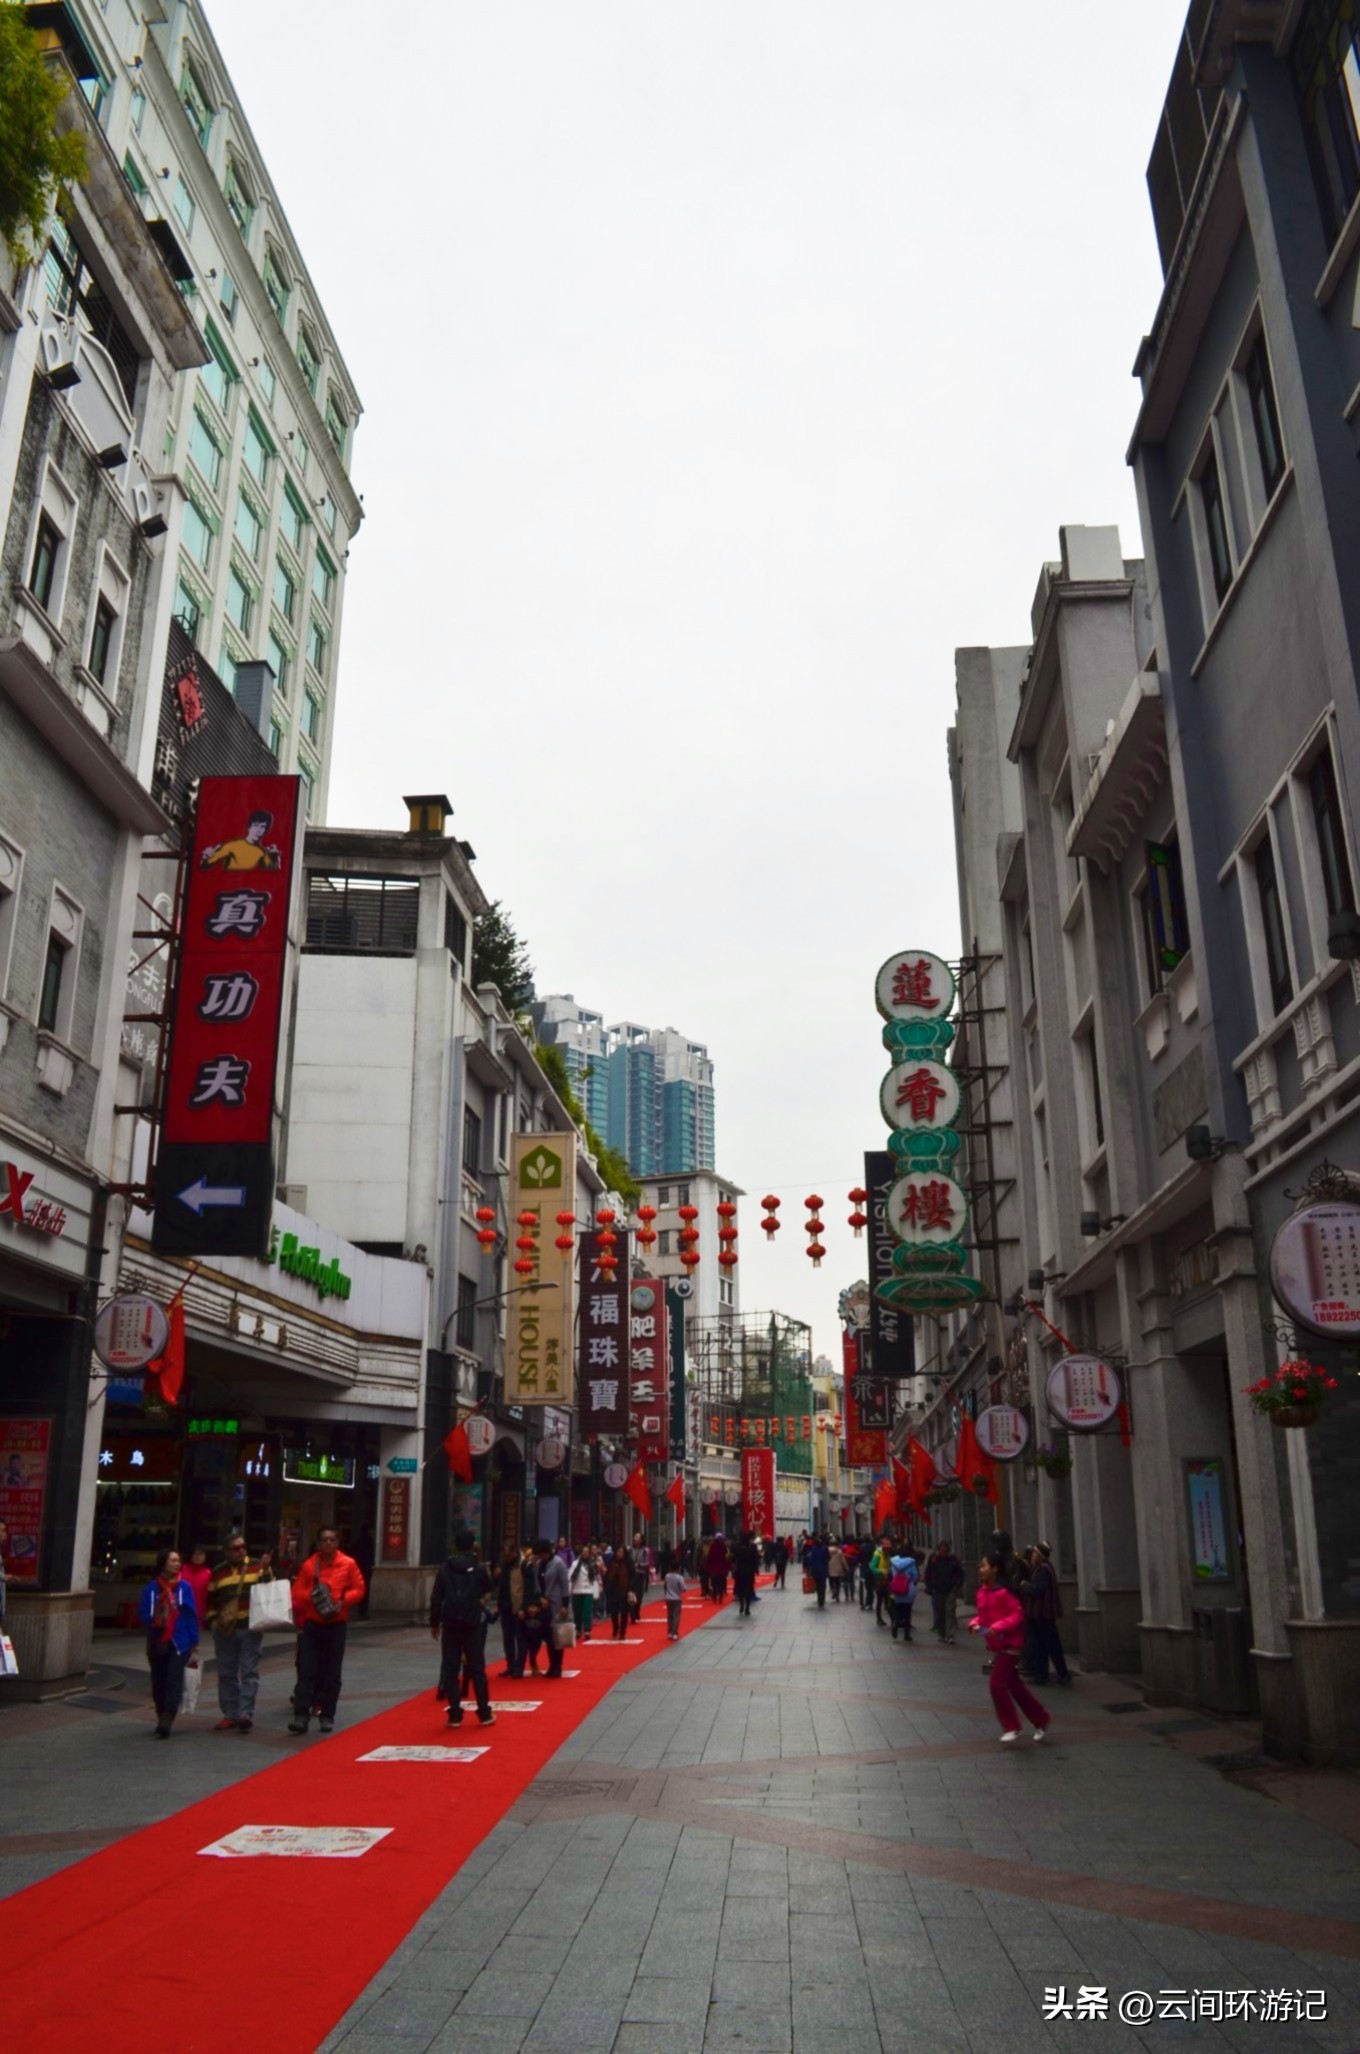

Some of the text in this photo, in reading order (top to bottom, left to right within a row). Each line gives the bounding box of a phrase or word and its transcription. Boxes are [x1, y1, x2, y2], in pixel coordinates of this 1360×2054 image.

[192, 889, 270, 1106] 真功夫
[891, 957, 956, 1233] 蓮香樓
[517, 1304, 541, 1394] HOUSE
